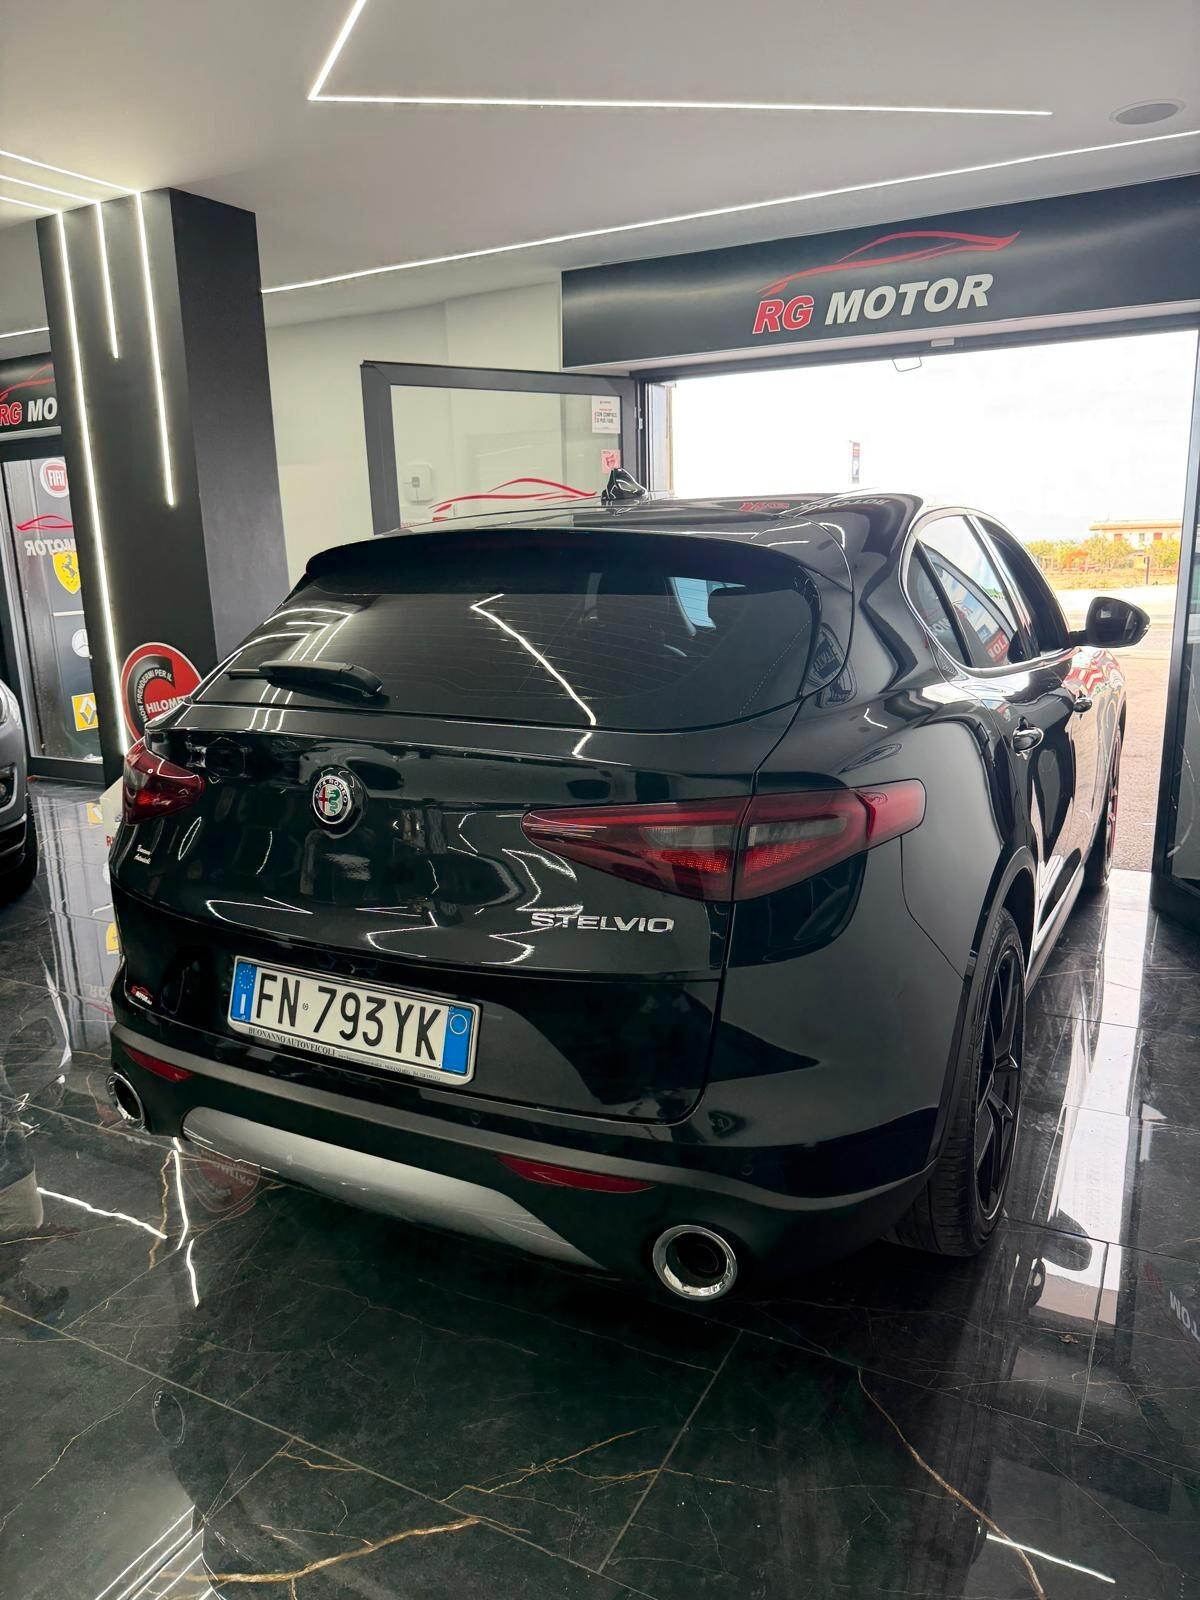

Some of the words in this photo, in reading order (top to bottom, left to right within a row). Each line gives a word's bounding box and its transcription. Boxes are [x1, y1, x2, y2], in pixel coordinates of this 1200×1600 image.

[752, 295, 815, 334] RG
[824, 273, 994, 325] MOTOR
[47, 469, 66, 487] FIAT
[154, 669, 167, 678] PER
[530, 912, 675, 933] STELVIO
[286, 1038, 336, 1057] AUTOVEICOLI
